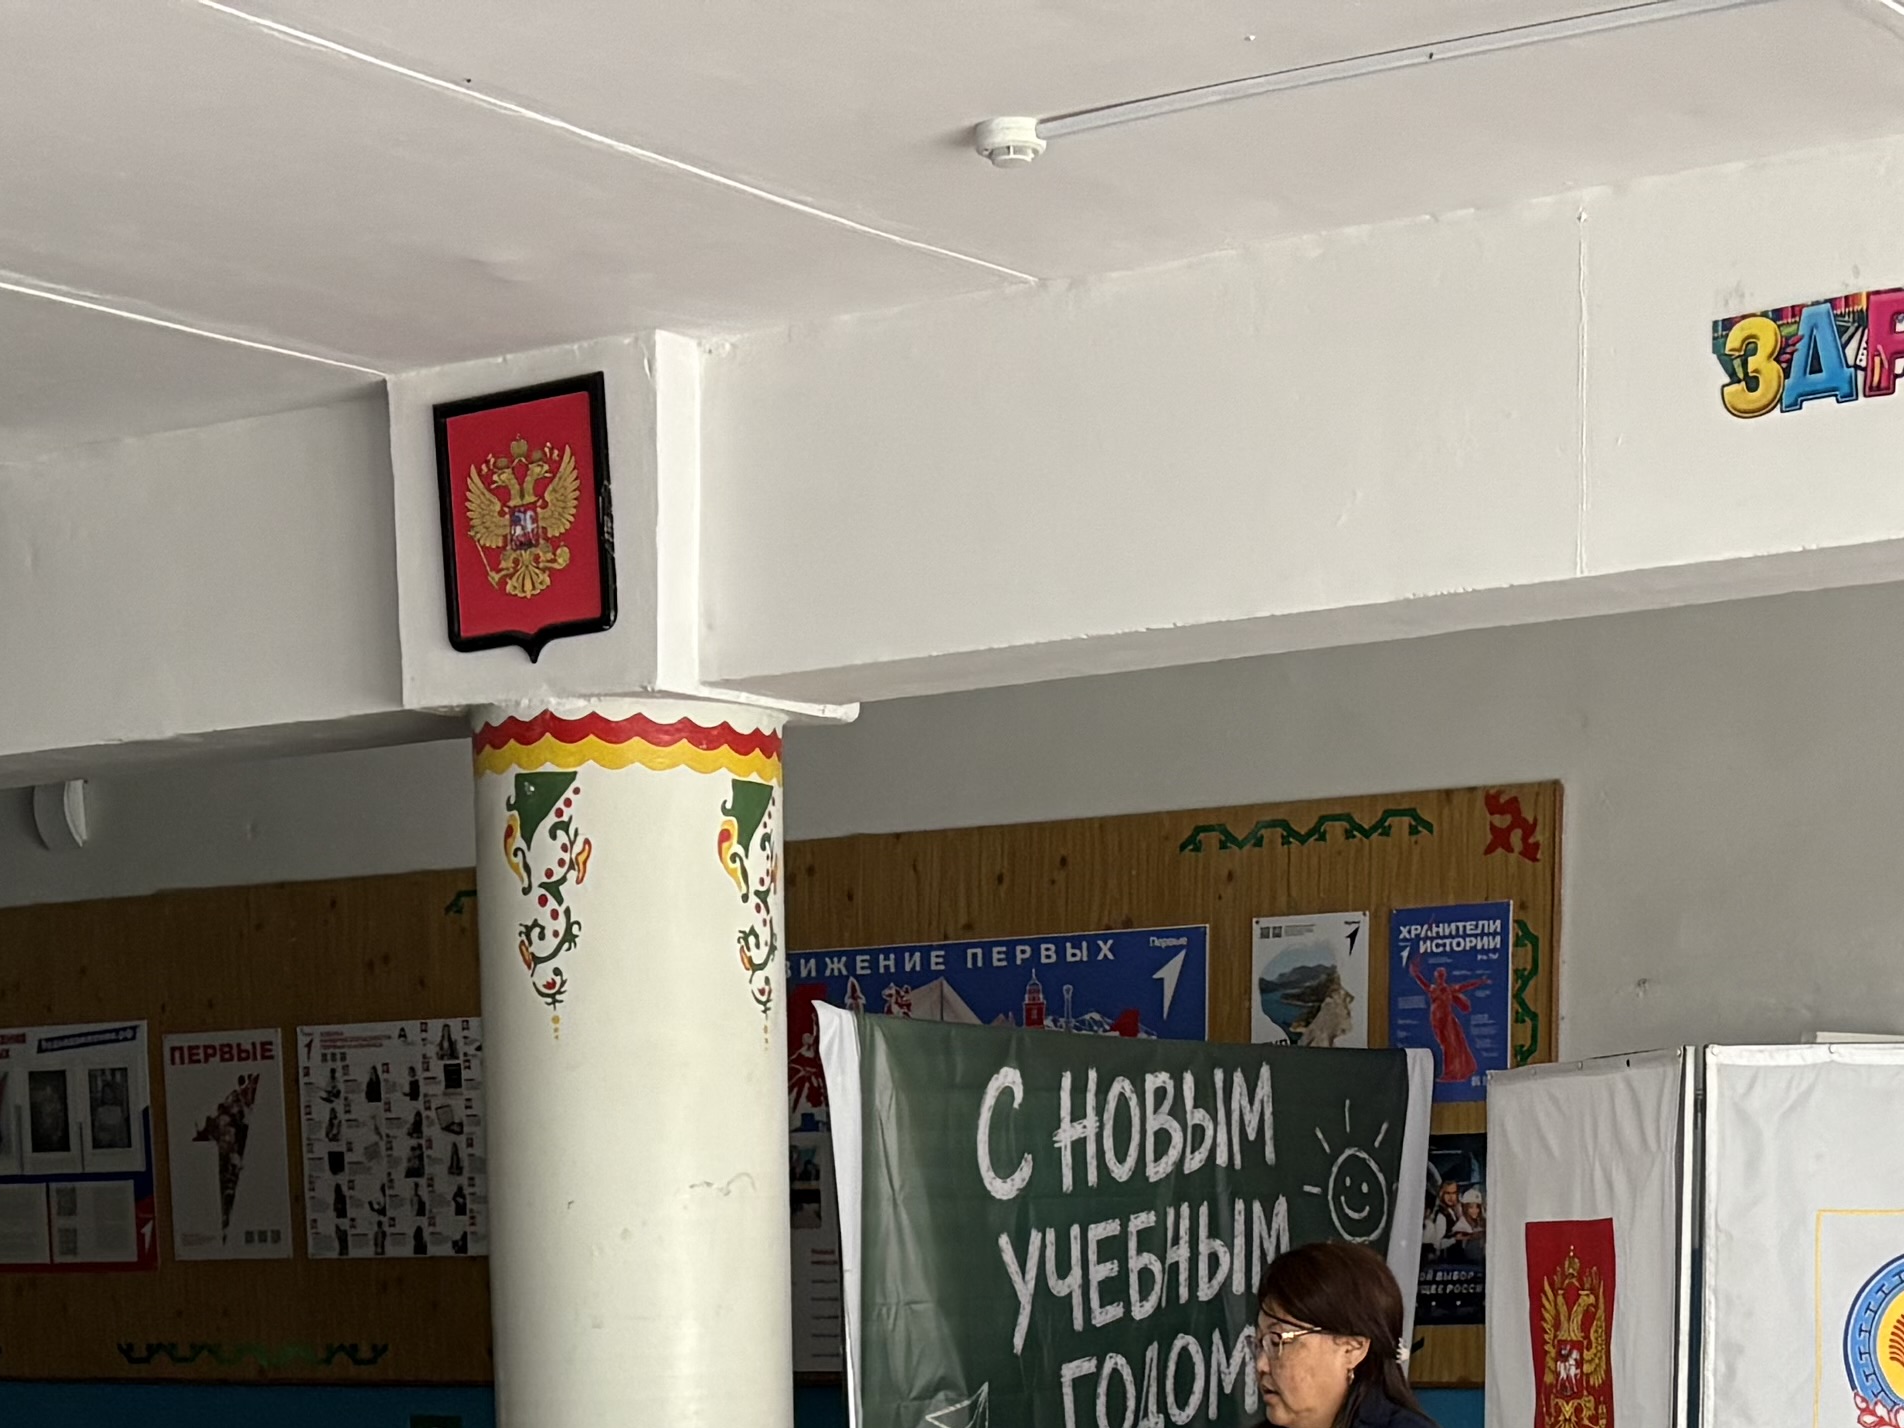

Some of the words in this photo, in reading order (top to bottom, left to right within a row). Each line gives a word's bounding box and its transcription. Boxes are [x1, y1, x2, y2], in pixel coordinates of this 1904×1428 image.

[1399, 919, 1501, 939] ХРАНИТЕЛИ
[967, 939, 1115, 968] ПЕРВЫХ
[1419, 935, 1501, 953] ИСТОРИИ
[169, 1040, 275, 1066] ПЕРВЫЕ
[977, 1066, 1034, 1200] С
[1052, 1061, 1276, 1194] НОВЫМ
[998, 1194, 1291, 1357] УЧЕБНЫМ
